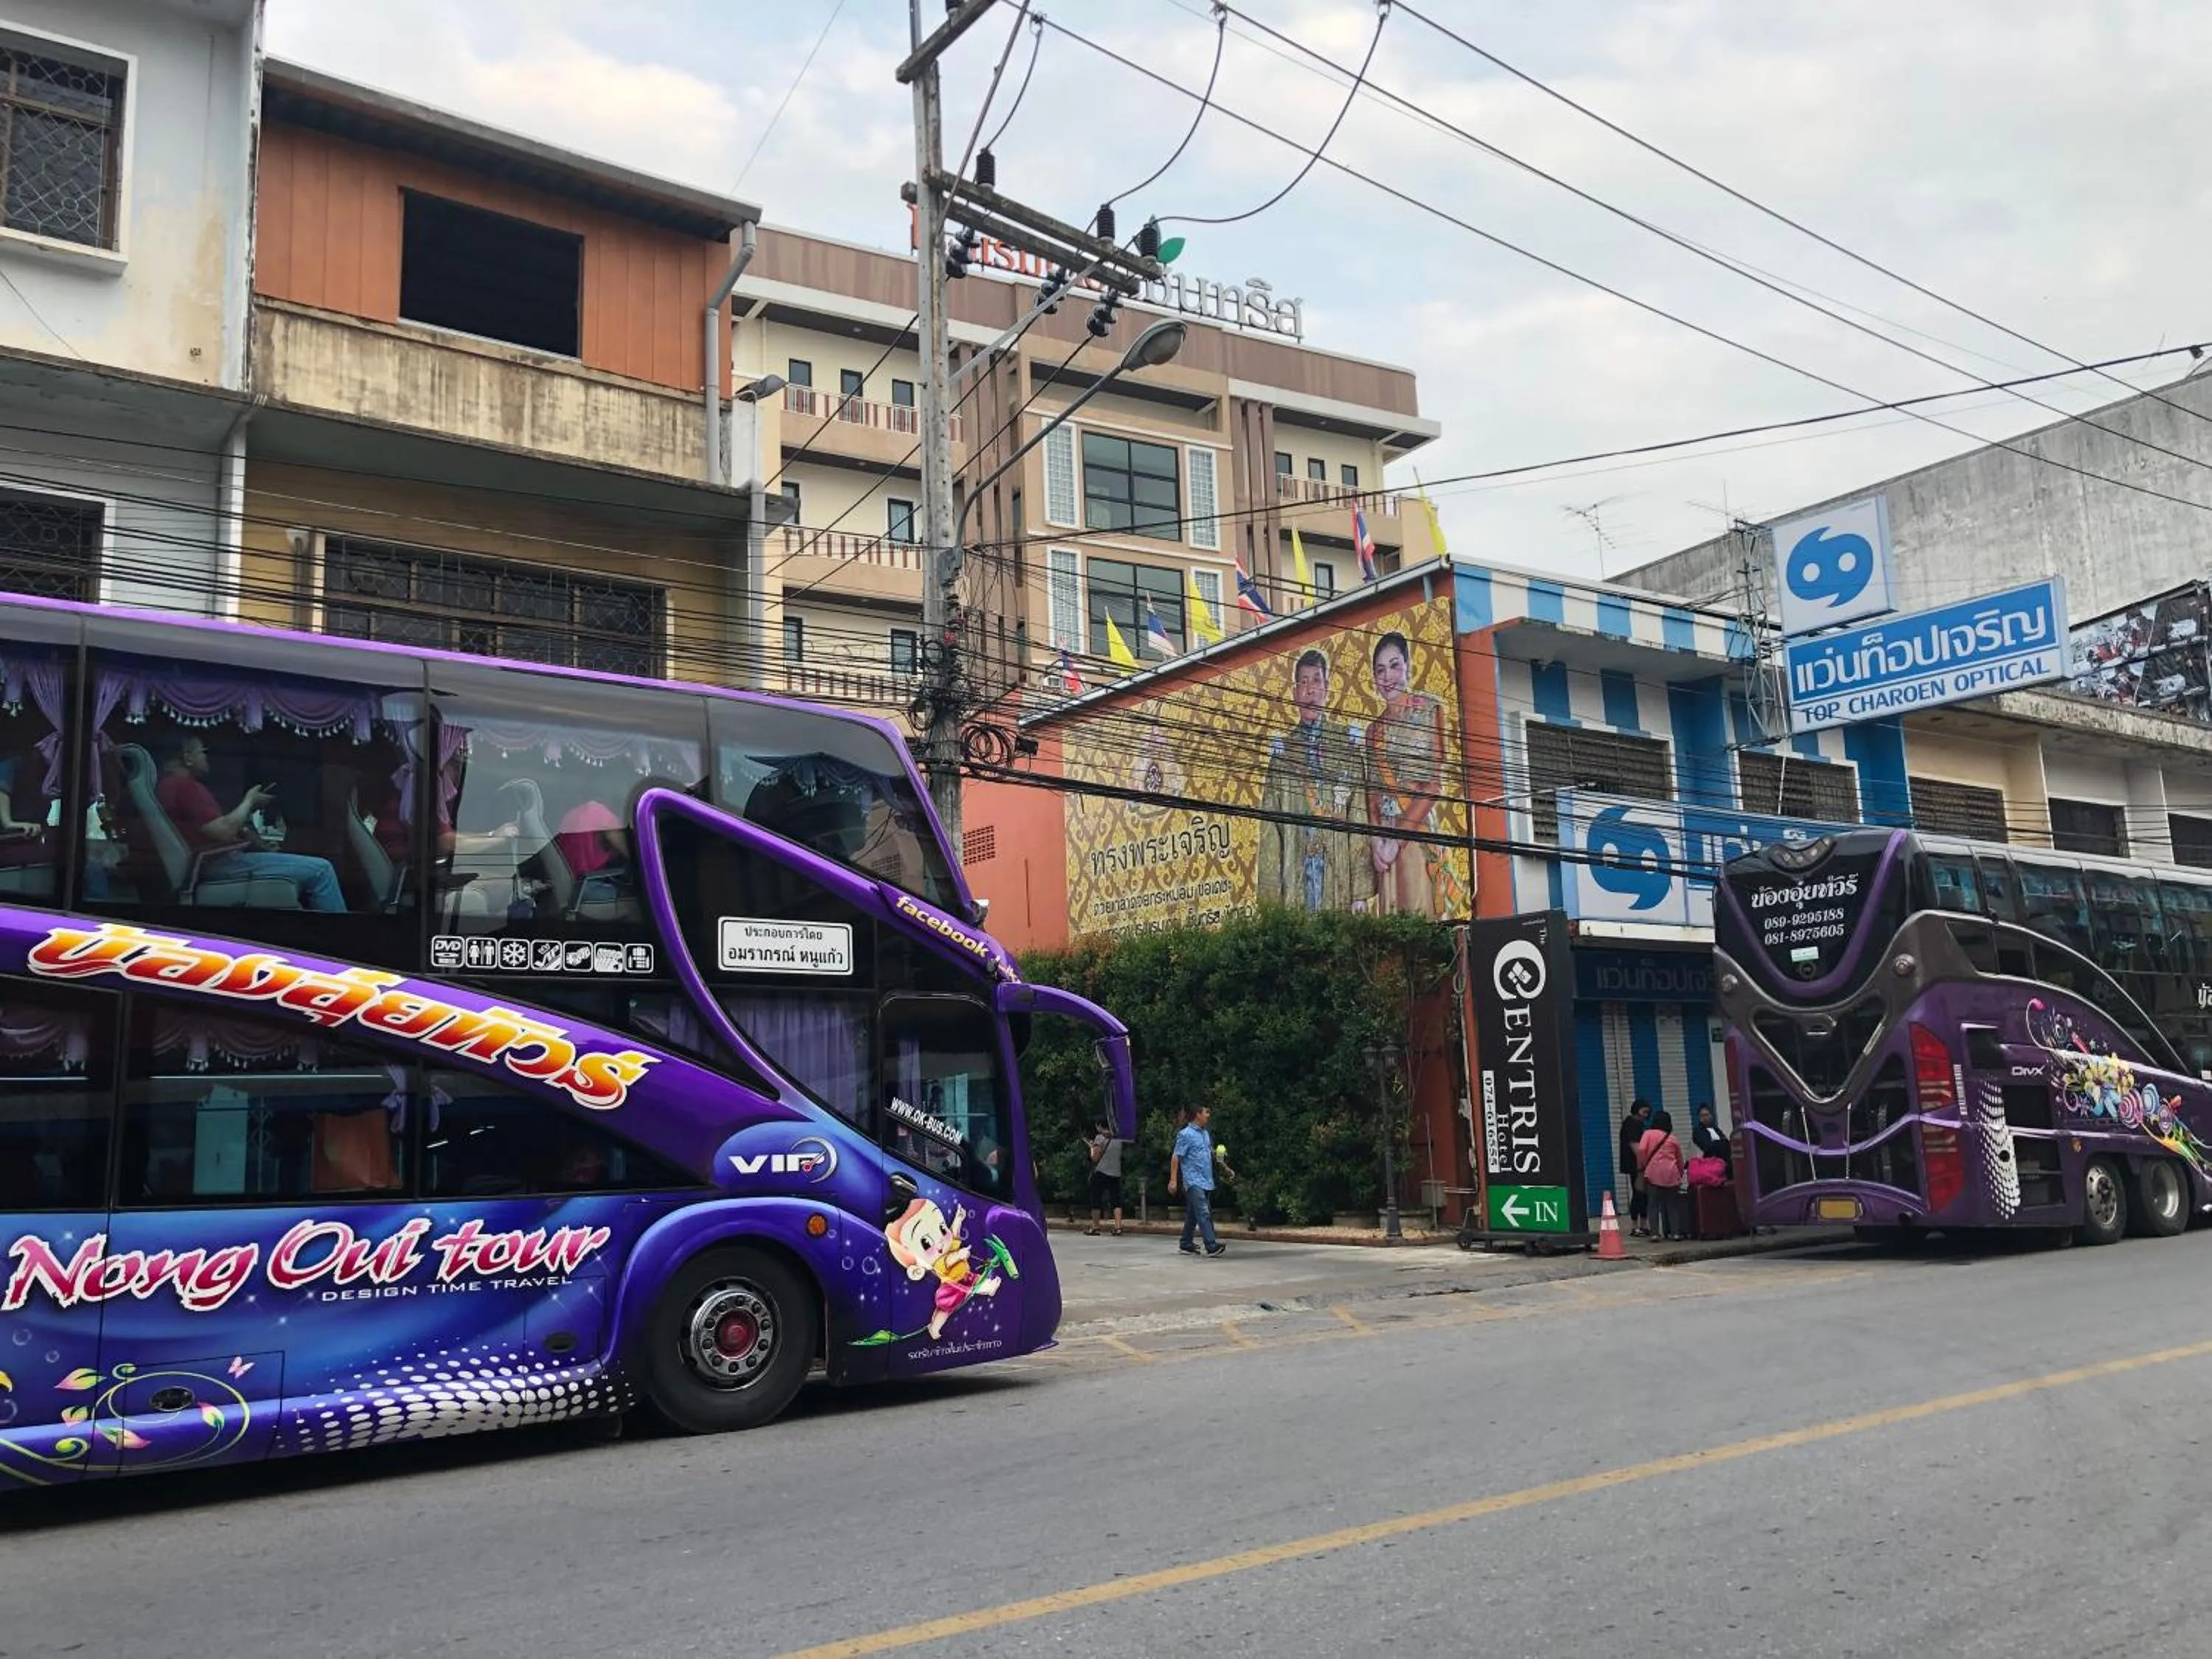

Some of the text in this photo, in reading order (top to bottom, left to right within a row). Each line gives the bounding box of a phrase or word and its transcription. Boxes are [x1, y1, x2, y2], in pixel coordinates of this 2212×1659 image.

[1795, 605, 2047, 692] แว่นท็อปเจริญ
[1804, 657, 2051, 723] TOP CHAROEN OPTICAL
[1091, 815, 1231, 876] ทรงพระเจริญ
[434, 939, 462, 950] DVD
[745, 926, 823, 940] ประกอบการโดย
[896, 896, 990, 958] facebook
[1764, 923, 1845, 945] 081-8975605
[728, 945, 843, 968] อมราภรณ์ หนูแก้ว
[1493, 939, 1546, 1174] CENTRIS
[728, 1153, 827, 1174] VIP
[1497, 1113, 1512, 1172] Hotel
[1534, 1201, 1559, 1222] IN
[1, 1217, 611, 1312] Nong Oui tour
[322, 1276, 573, 1302] DESIGN TIME TRAVEL
